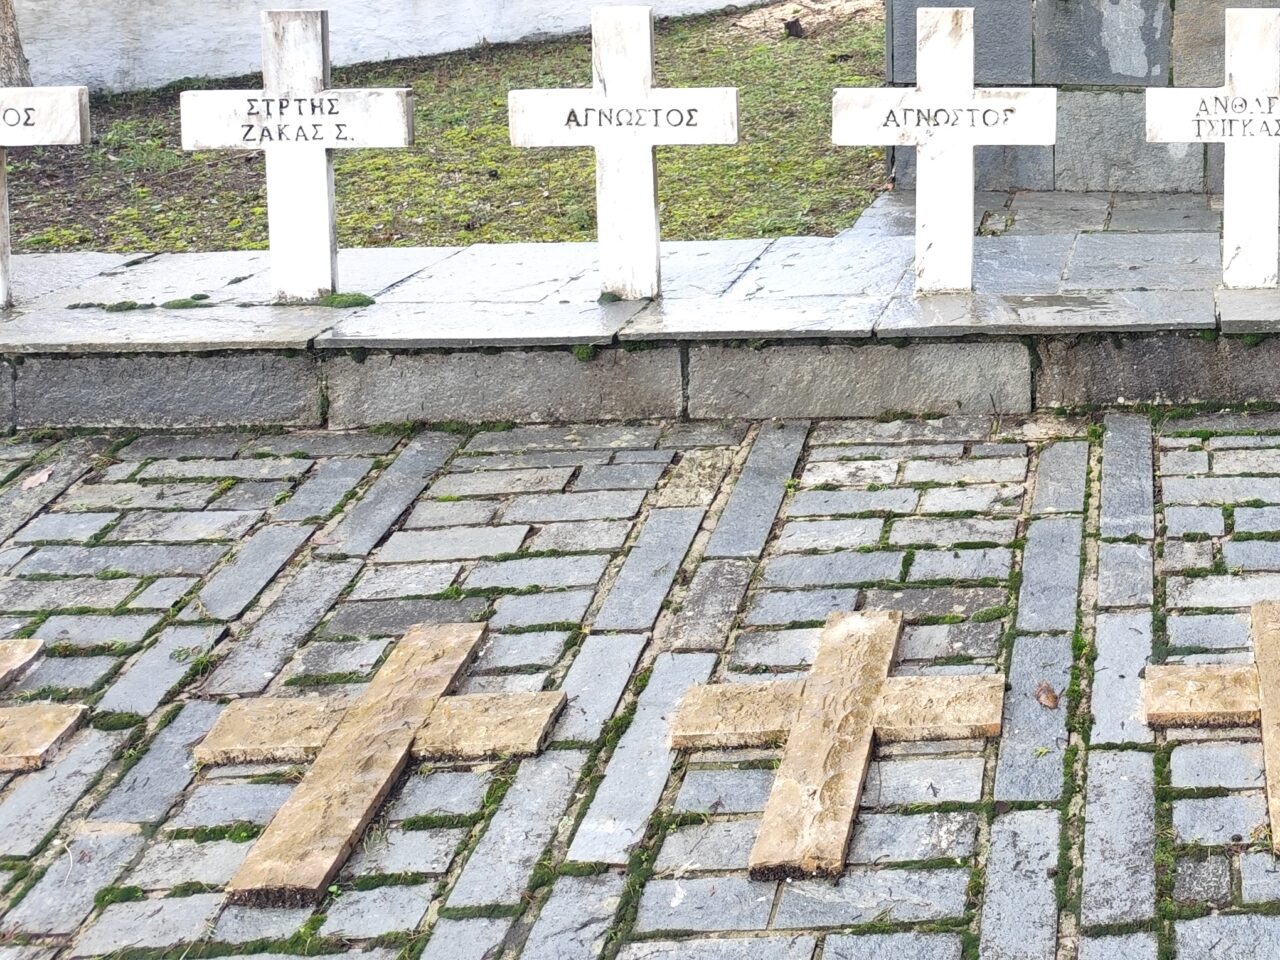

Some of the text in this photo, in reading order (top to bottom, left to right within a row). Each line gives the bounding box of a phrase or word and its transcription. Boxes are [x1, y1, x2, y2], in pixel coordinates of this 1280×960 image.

[246, 96, 341, 118] ΣΤΡΤΗΣ
[564, 108, 698, 128] ΑΓΝΩΣΤΟΣ
[882, 108, 1016, 128] ΑΓΝΩΣΤΟΣ
[240, 122, 354, 144] ΖΑΚΑΣ Σ.
